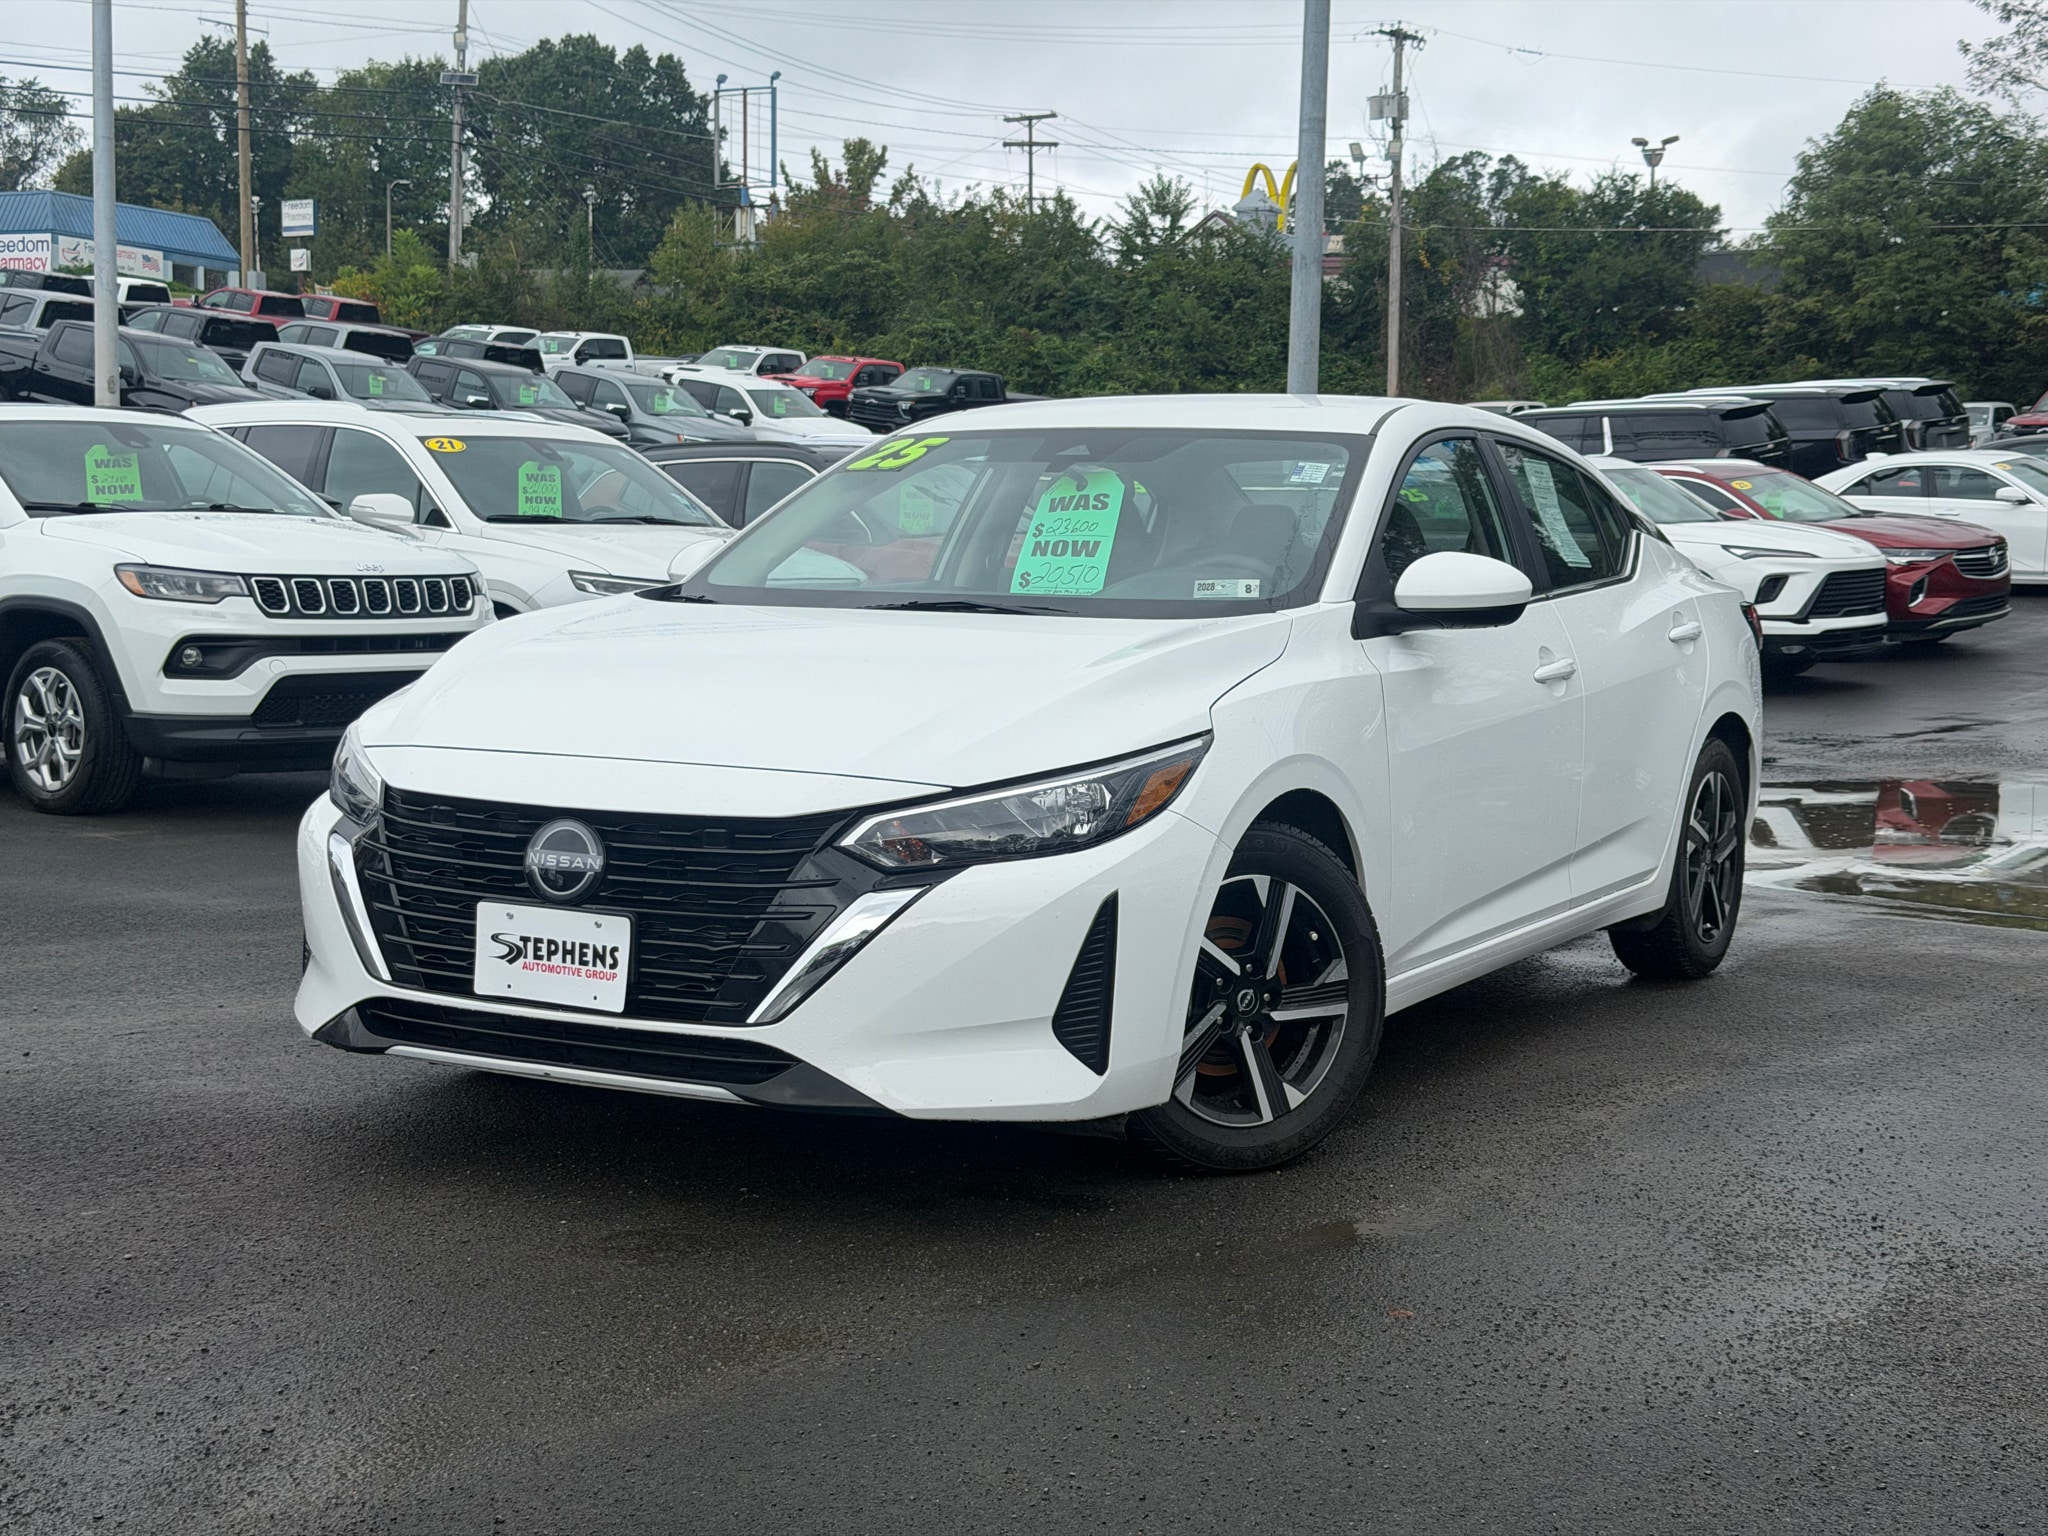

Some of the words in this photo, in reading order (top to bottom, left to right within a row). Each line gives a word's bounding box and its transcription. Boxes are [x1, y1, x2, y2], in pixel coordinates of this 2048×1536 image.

[284, 201, 312, 210] Freedom
[0, 236, 49, 253] eedom
[0, 257, 48, 272] armacy
[435, 440, 456, 450] 21
[845, 437, 950, 470] 25
[94, 458, 133, 469] WAS
[525, 473, 556, 482] WAS
[95, 484, 135, 495] NOW
[525, 496, 557, 504] NOW
[1048, 493, 1111, 513] WAS
[1031, 540, 1102, 558] NOW
[356, 562, 385, 573] Jeep
[1197, 582, 1216, 592] 2028
[1244, 584, 1253, 593] 8
[529, 852, 600, 870] NISSAN
[488, 932, 619, 970] STEPHENS
[522, 961, 582, 978] AUTOMOTIVE
[585, 968, 618, 982] GROUP
